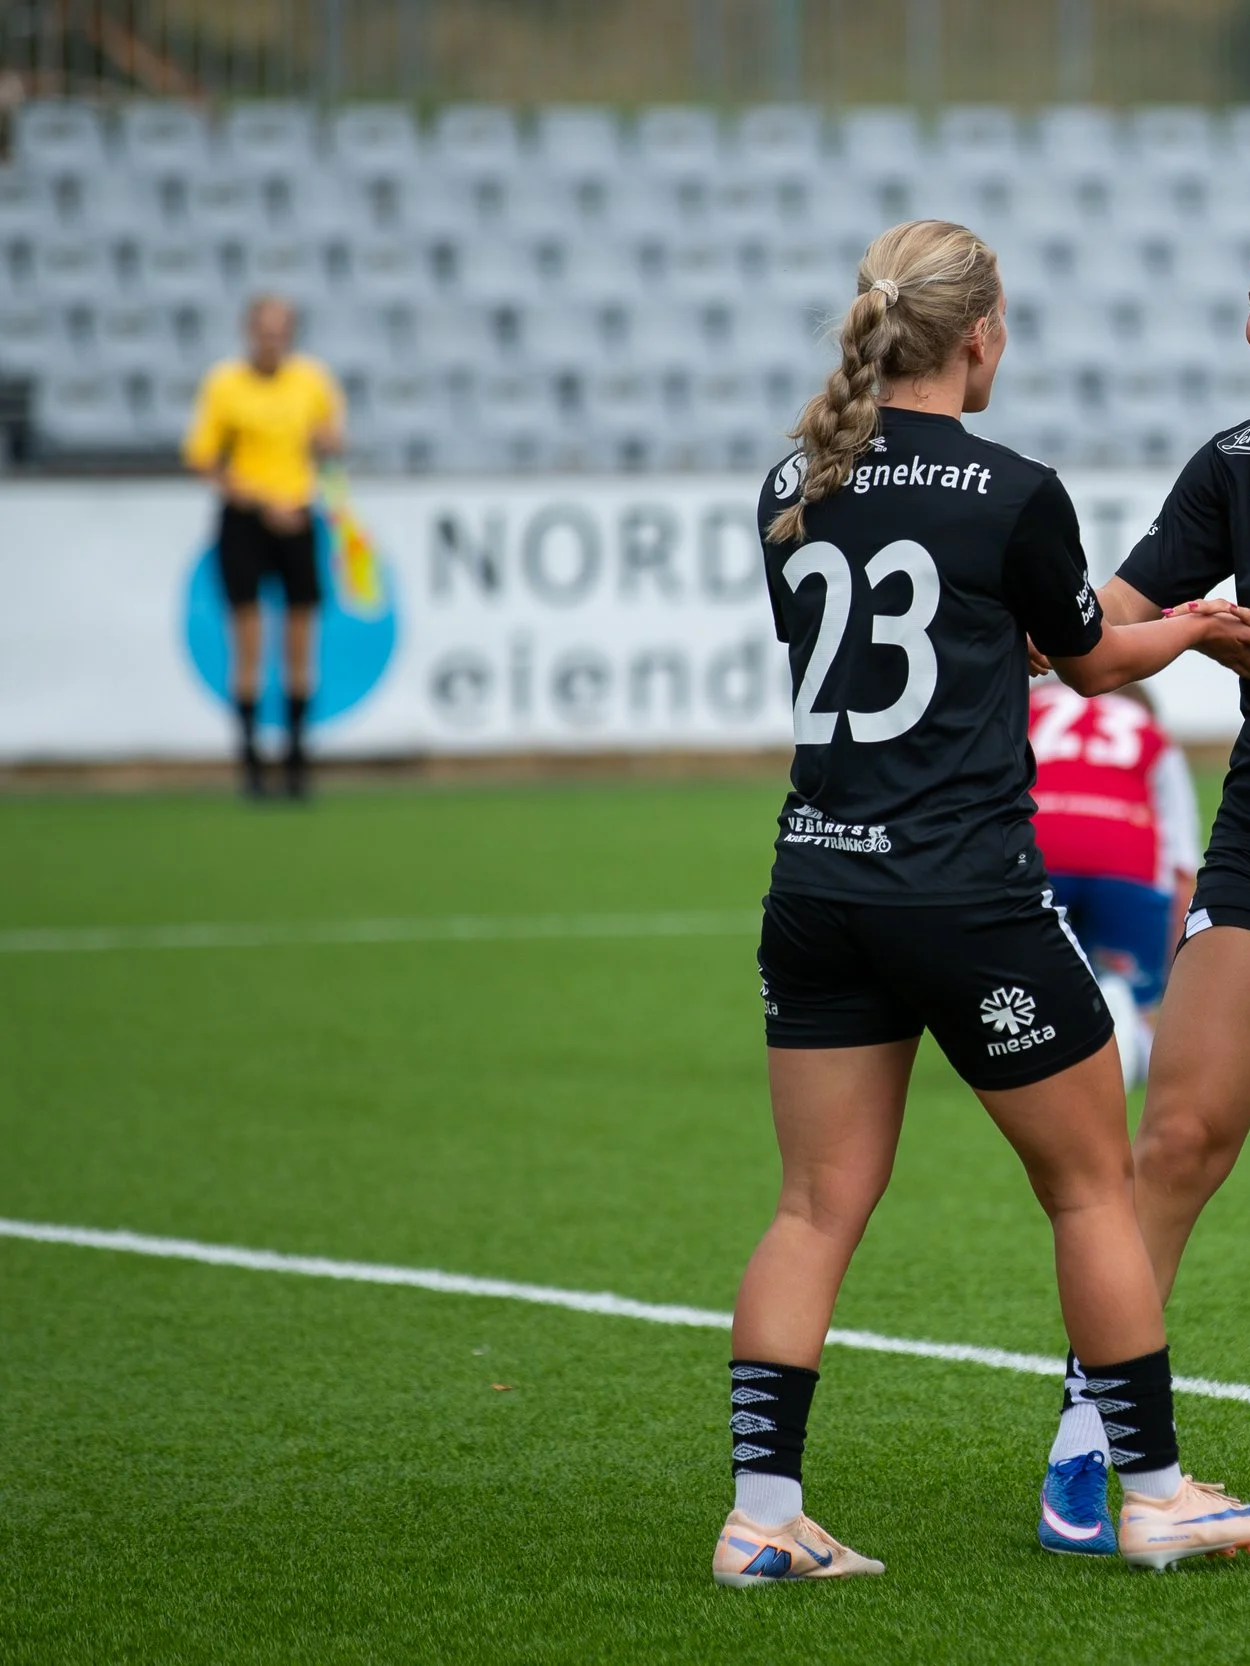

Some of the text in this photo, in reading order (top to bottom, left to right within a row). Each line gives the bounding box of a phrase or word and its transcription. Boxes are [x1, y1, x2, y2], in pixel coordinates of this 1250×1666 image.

[430, 632, 774, 726] eiend
[782, 539, 941, 745] 23
[1030, 682, 1149, 769] 23
[987, 1023, 1056, 1057] mesta
